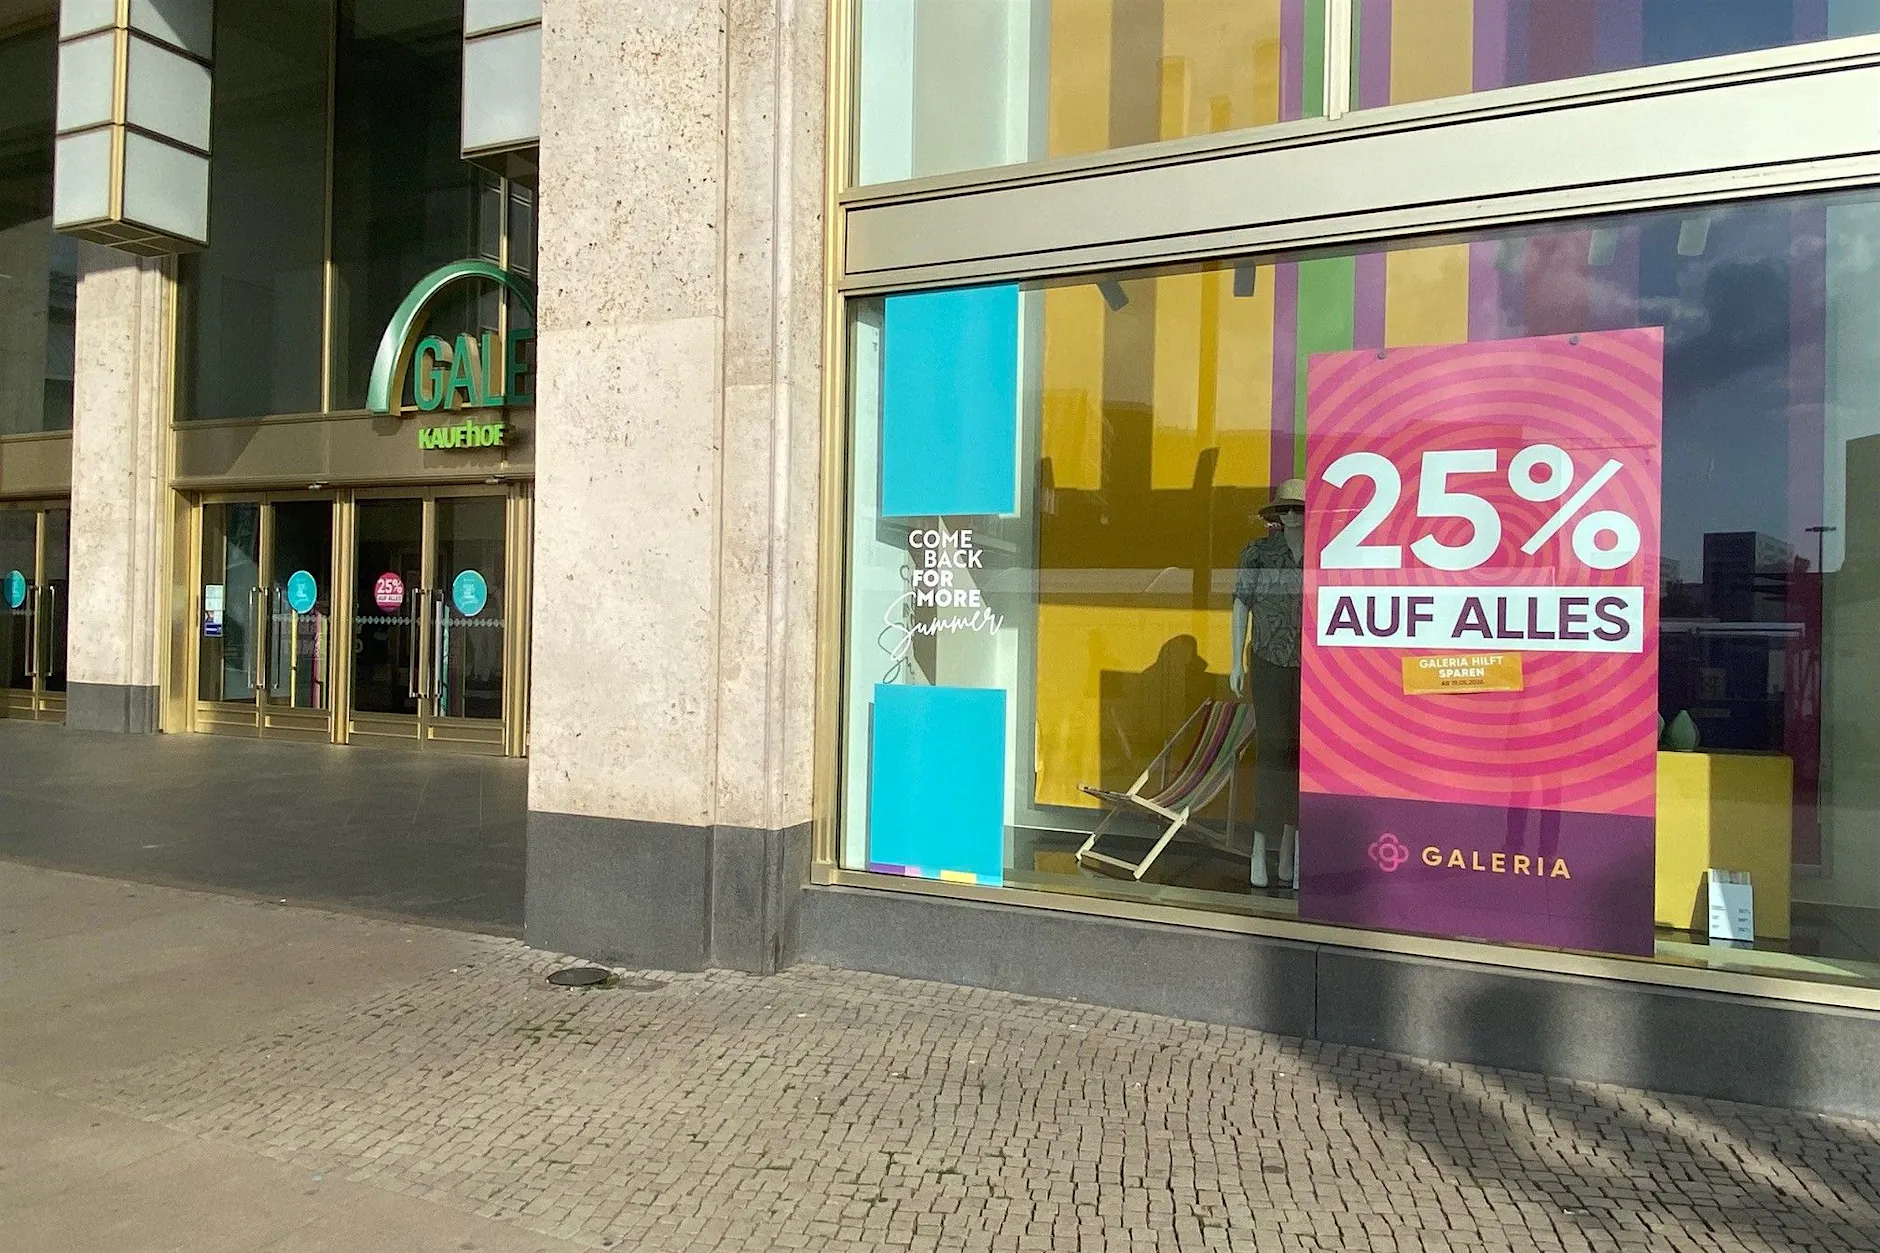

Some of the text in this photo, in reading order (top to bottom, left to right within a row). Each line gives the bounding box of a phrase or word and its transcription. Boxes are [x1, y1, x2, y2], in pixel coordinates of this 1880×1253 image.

[1319, 443, 1642, 571] 25%
[908, 529, 973, 549] COME
[924, 549, 983, 569] BACK
[377, 579, 402, 594] 25%
[912, 569, 954, 588] FOR
[916, 589, 981, 608] MORE
[883, 591, 1004, 662] Summer
[1325, 593, 1631, 643] AUF ALLES
[1419, 656, 1503, 668] GALERIA HILFT
[1439, 668, 1484, 678] SPAREN
[1421, 846, 1572, 880] GALERIA
